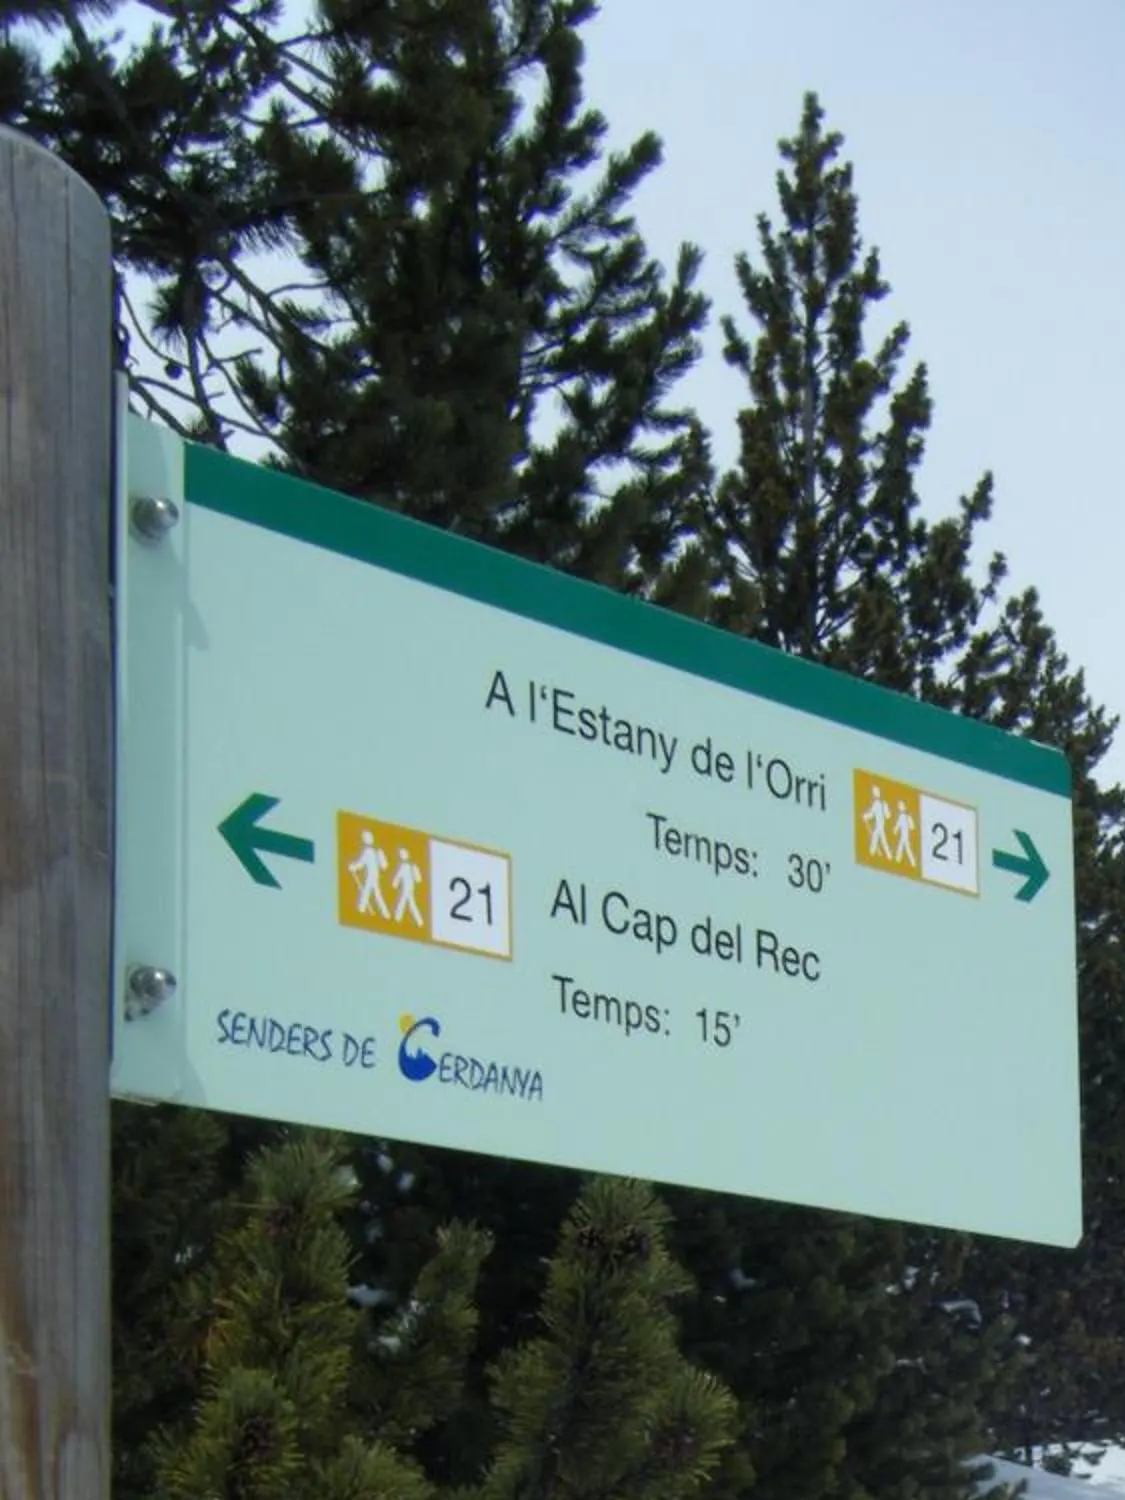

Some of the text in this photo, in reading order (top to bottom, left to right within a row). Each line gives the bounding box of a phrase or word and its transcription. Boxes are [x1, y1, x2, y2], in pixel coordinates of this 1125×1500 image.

[485, 669, 516, 717] A
[690, 736, 736, 784] de
[646, 811, 760, 878] Temps:
[930, 821, 964, 866] 21
[448, 876, 493, 926] 21
[549, 878, 821, 983] Al Cap del Rec
[550, 973, 671, 1037] Temps:
[216, 1008, 334, 1063] SENDERS
[342, 1032, 377, 1069] DE
